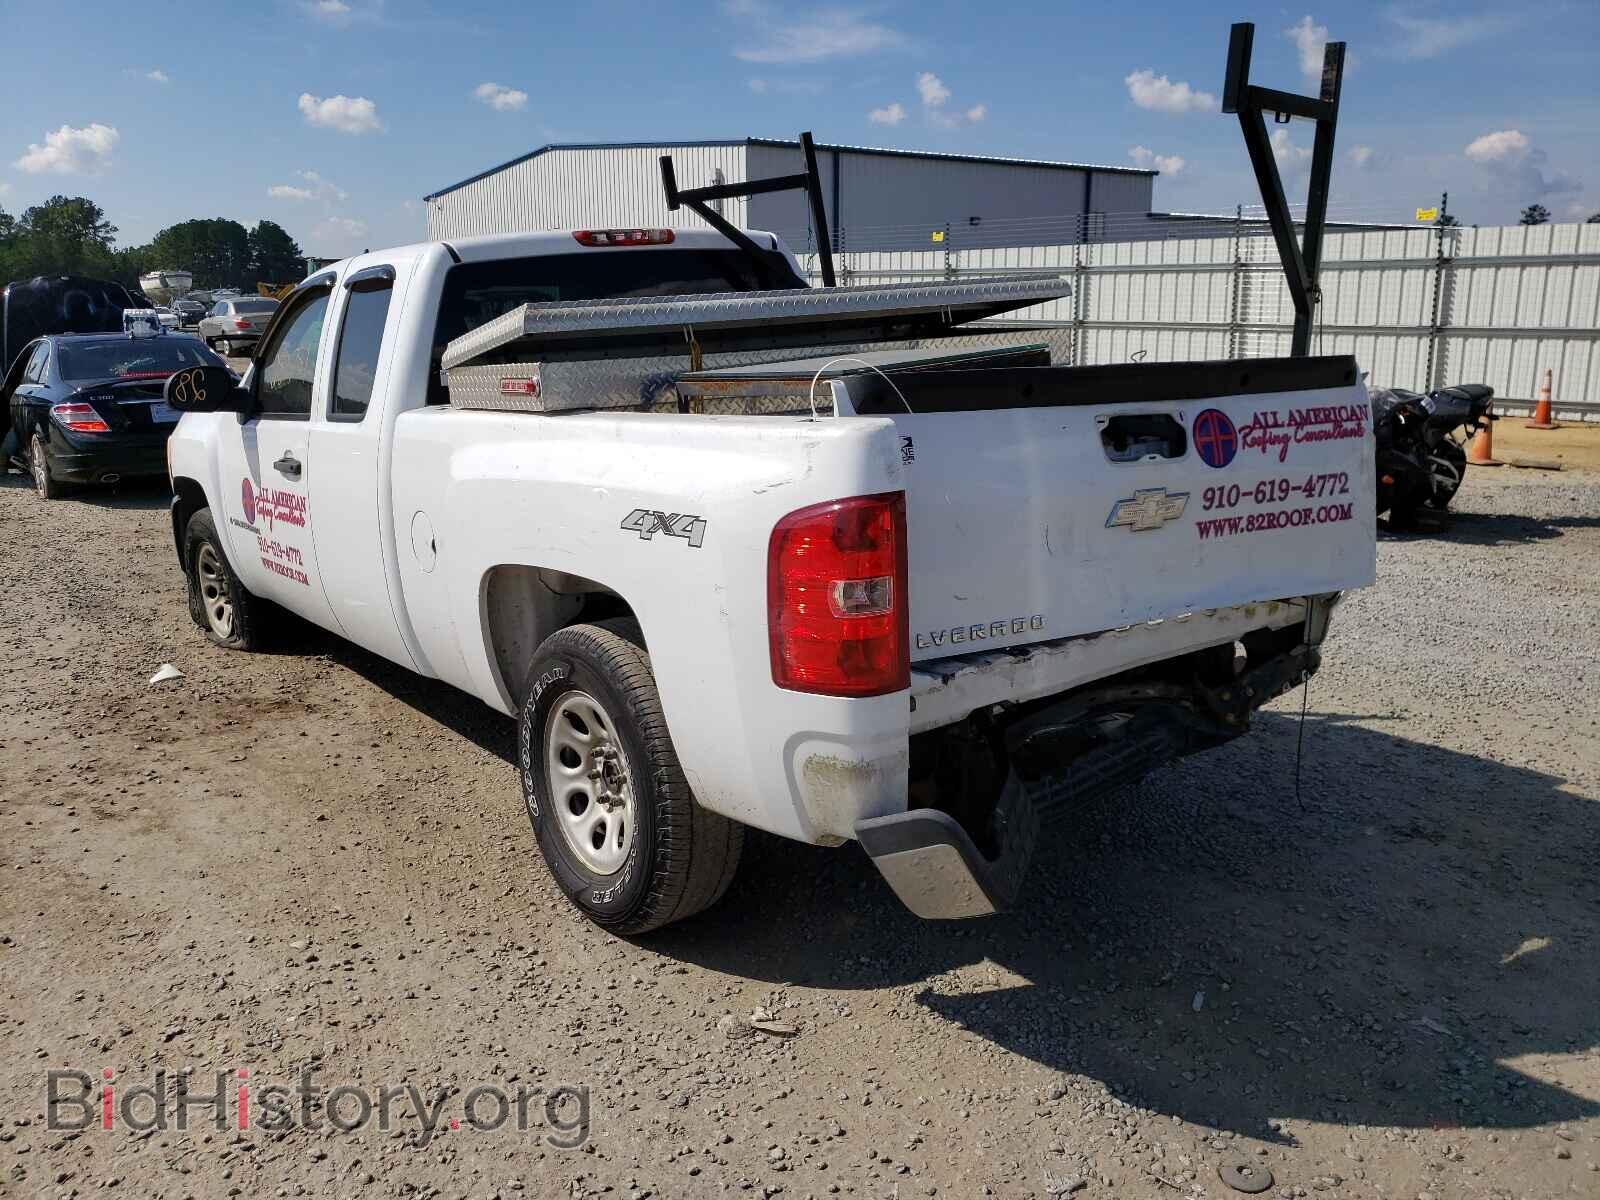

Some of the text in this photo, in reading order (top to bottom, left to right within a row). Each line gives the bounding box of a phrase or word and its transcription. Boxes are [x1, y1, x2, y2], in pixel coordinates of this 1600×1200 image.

[1250, 404, 1369, 430] ALL AMERICAN
[1238, 418, 1366, 462] Roofing Consultants
[1202, 472, 1350, 511] 910-619-4772
[1195, 503, 1353, 539] WWW.82ROOF.COM
[522, 666, 565, 817] GOODYEAR
